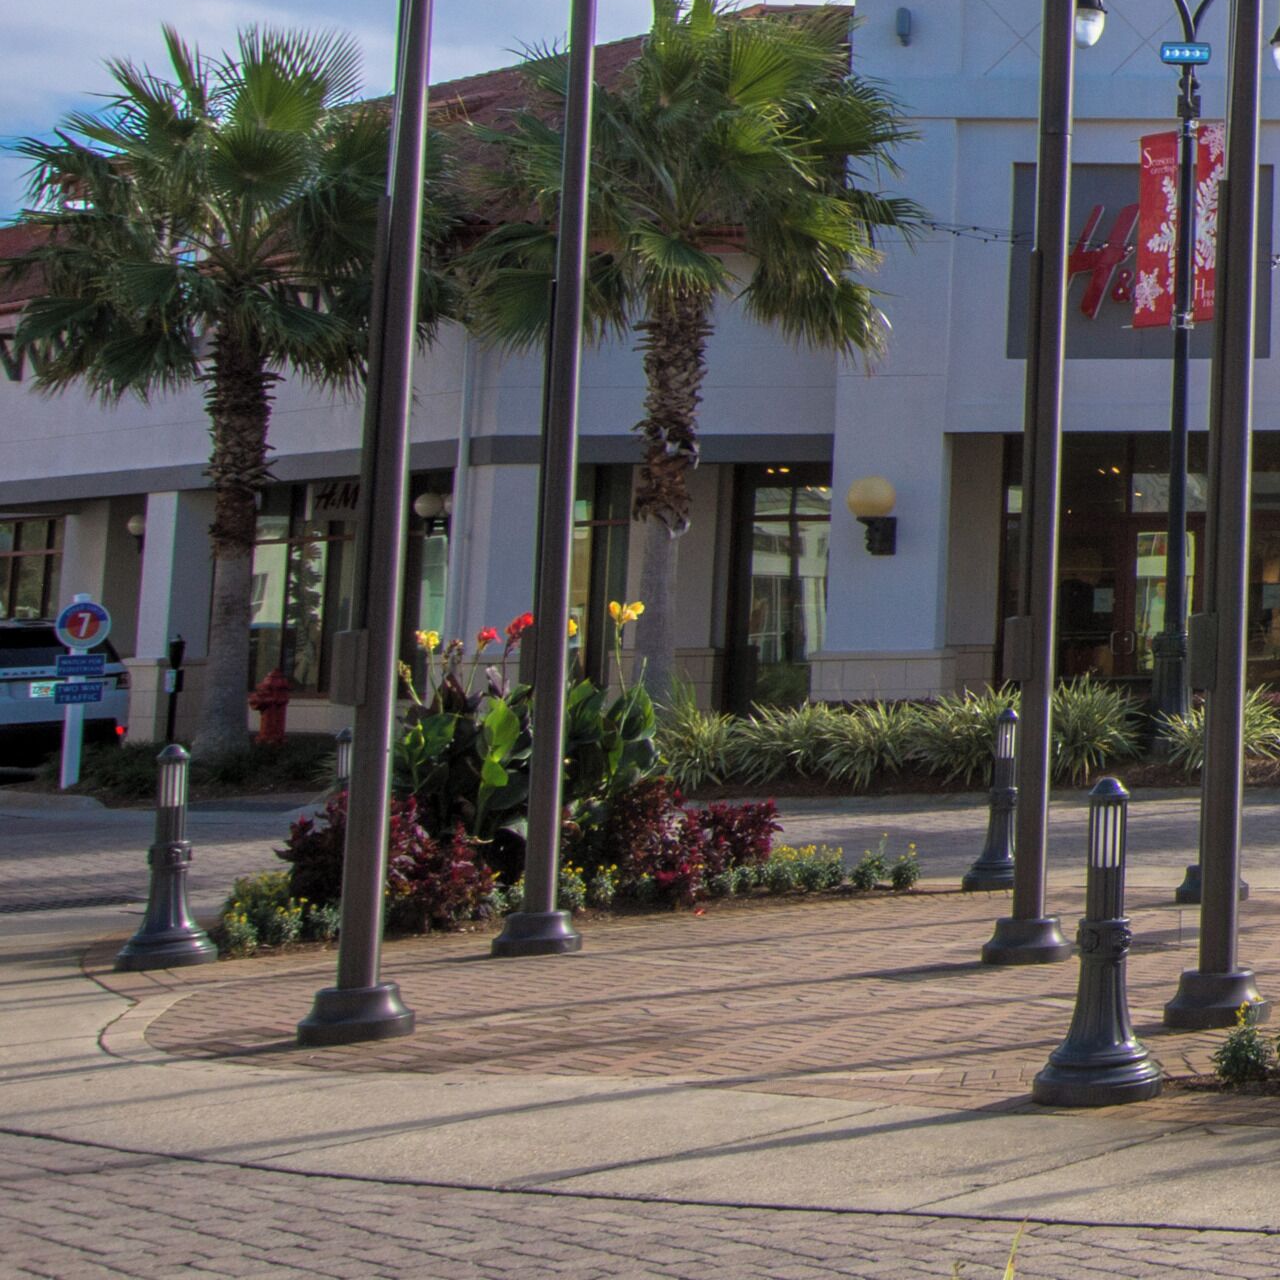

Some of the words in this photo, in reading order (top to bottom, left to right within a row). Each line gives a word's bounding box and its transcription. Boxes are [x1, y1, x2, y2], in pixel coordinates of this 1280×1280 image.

[77, 612, 92, 638] 7
[57, 685, 79, 693] TWO
[80, 684, 101, 692] WAY
[60, 692, 97, 701] TRAFFIC
